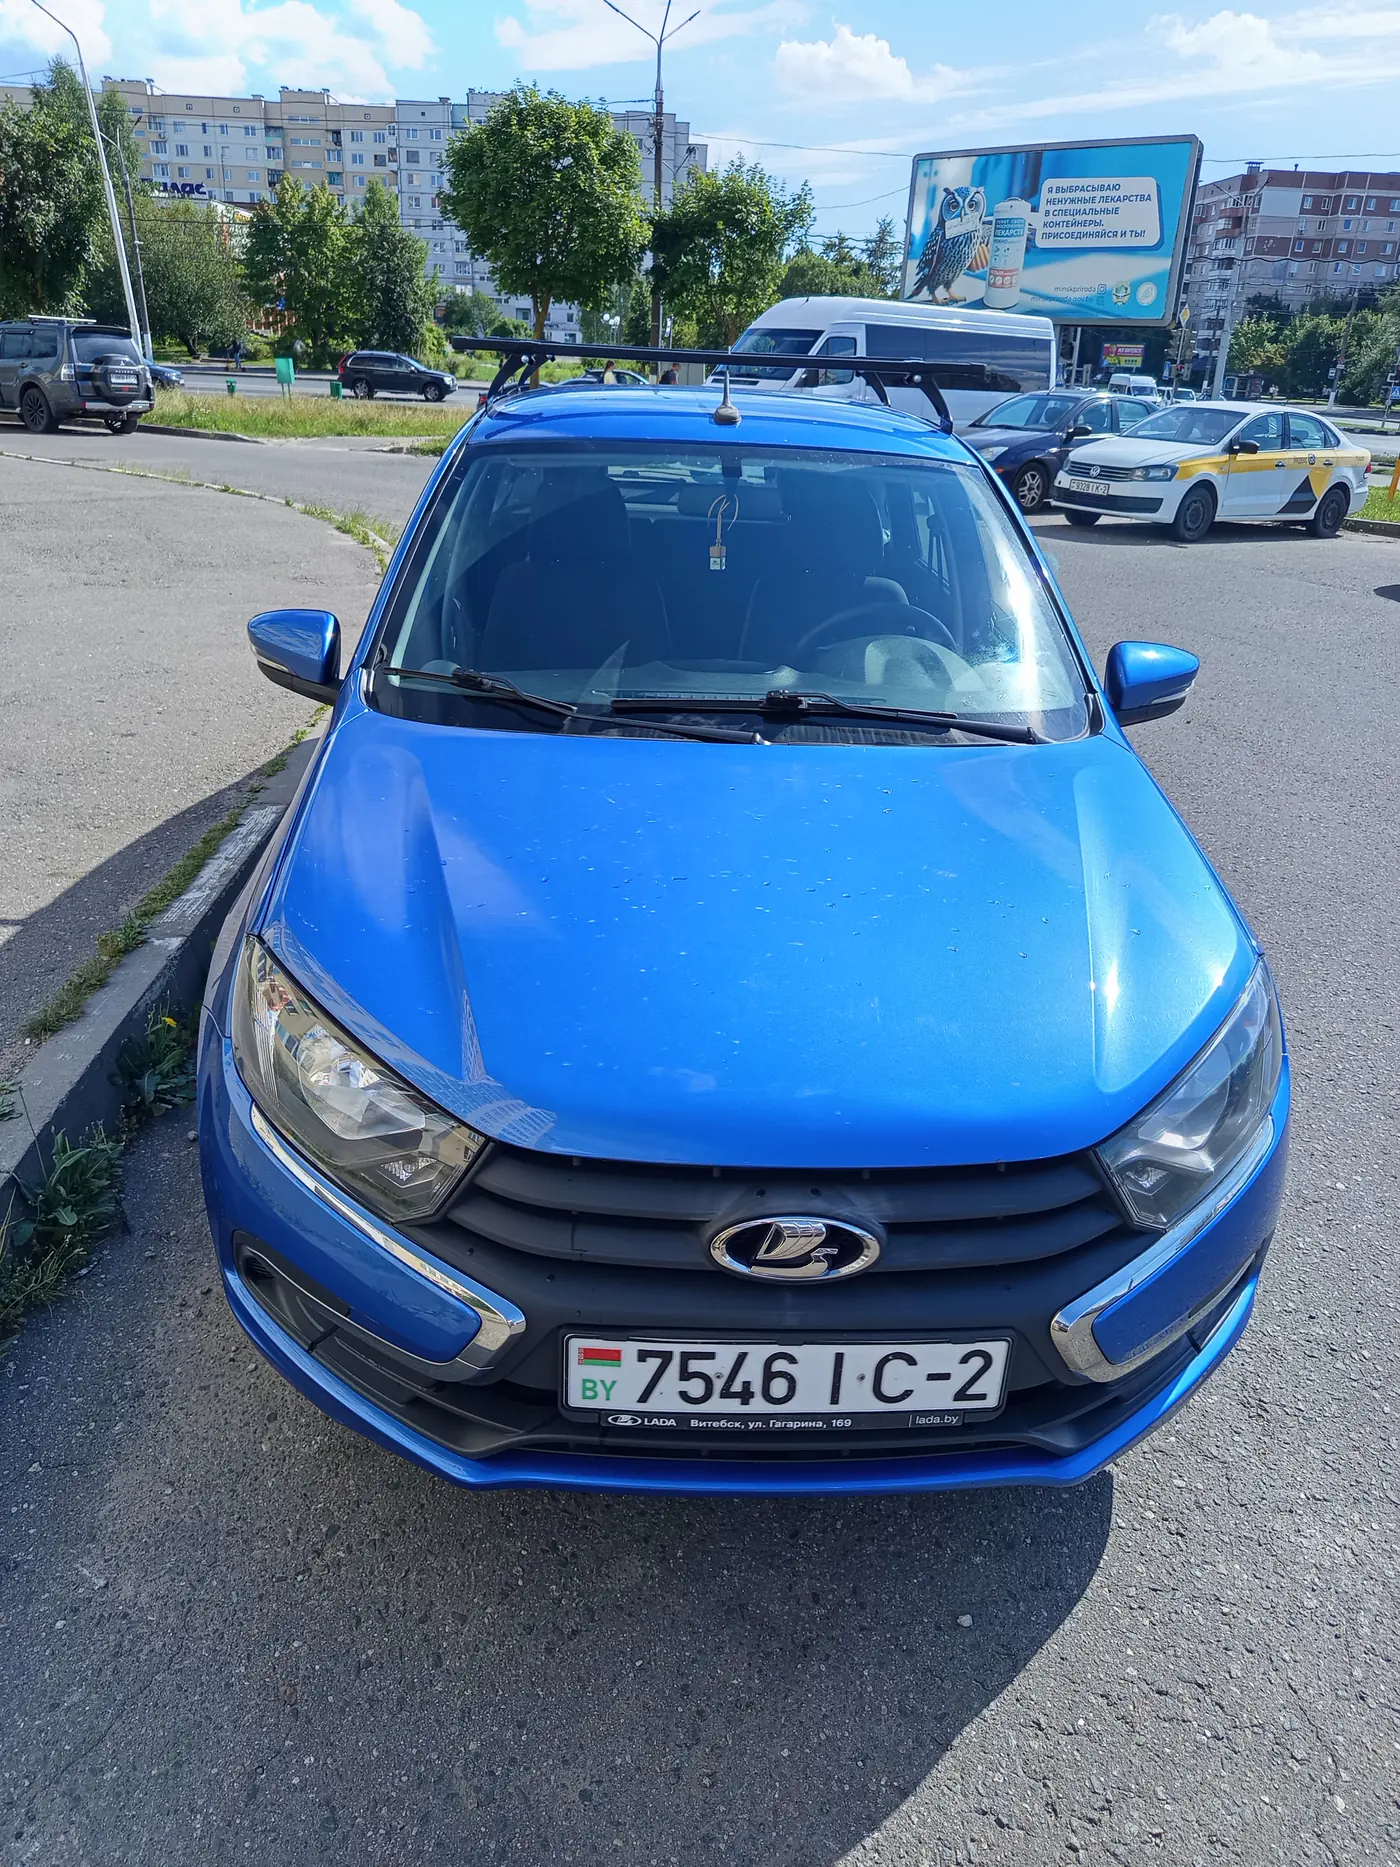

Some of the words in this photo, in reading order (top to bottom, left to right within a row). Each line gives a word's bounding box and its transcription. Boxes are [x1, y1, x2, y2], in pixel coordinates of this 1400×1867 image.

[1047, 186, 1053, 194] Я
[1055, 183, 1121, 194] ВЫБРАСЫВАЮ
[1045, 195, 1097, 206] НЕНУЖНЫЕ
[1097, 193, 1152, 204] ЛЕКАРСТВА
[1044, 209, 1050, 217] В
[1052, 206, 1120, 218] СПЕЦИАЛЬНЫЕ
[1042, 218, 1104, 229] КОНТЕЙНЕРЫ.
[1041, 229, 1119, 240] ПРИСОЕДИНЯЙСЯ
[1120, 230, 1127, 238] И
[1129, 229, 1146, 238] ТЫ!
[1053, 285, 1096, 294] minskpriroda
[636, 1348, 799, 1405] 7546
[580, 1378, 617, 1402] BY
[644, 1417, 677, 1427] LADA
[690, 1419, 745, 1429] Витебск,
[748, 1420, 766, 1430] ул.
[769, 1419, 827, 1429] Гагарина,
[831, 1418, 852, 1427] 169
[915, 1414, 959, 1425] lada.by
